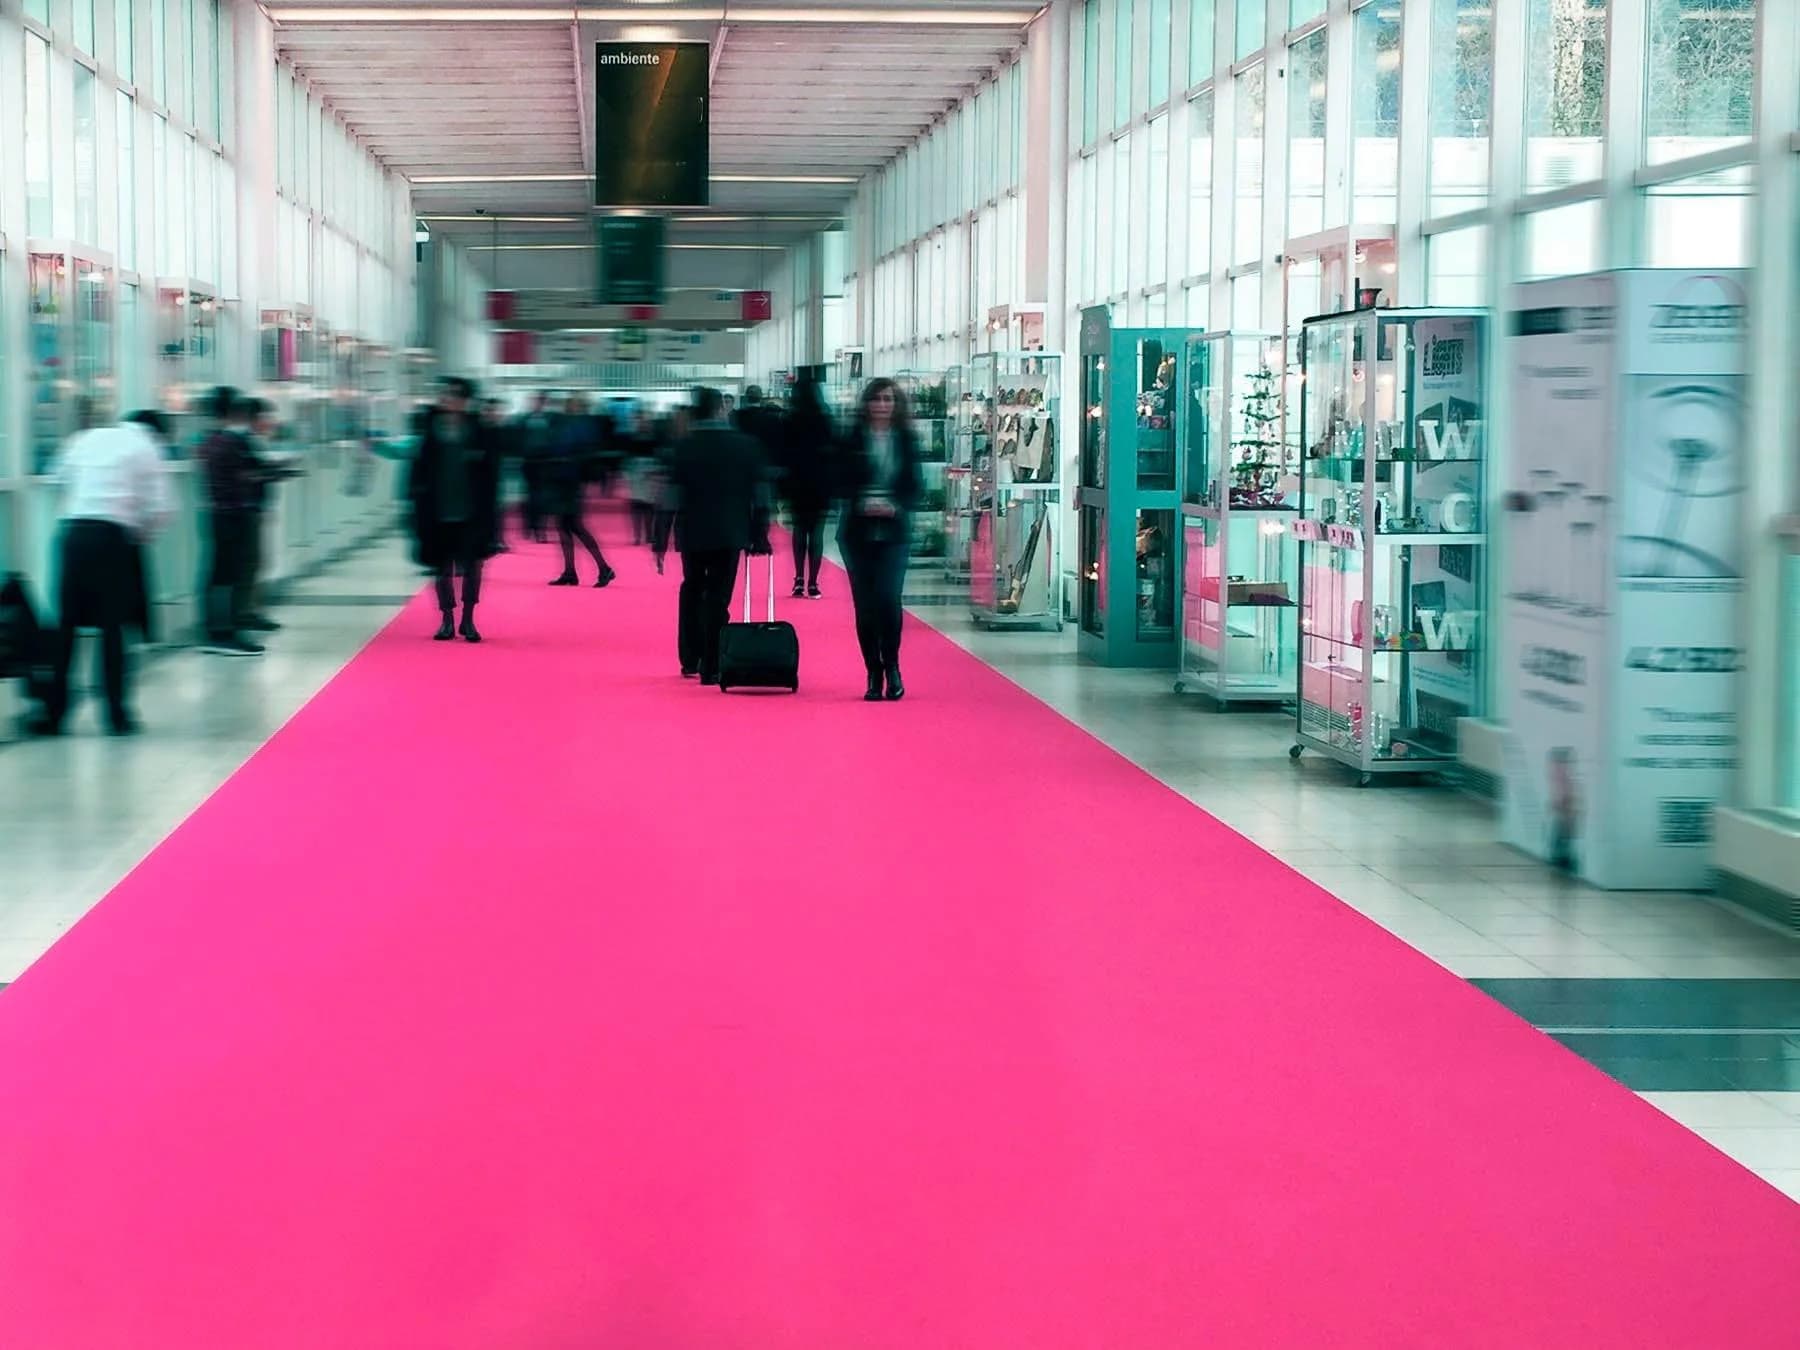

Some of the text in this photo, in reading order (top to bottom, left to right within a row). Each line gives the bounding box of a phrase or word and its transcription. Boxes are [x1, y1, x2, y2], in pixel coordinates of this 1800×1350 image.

[600, 51, 660, 65] ambiente
[1419, 420, 1485, 460] W
[1415, 609, 1480, 650] W
